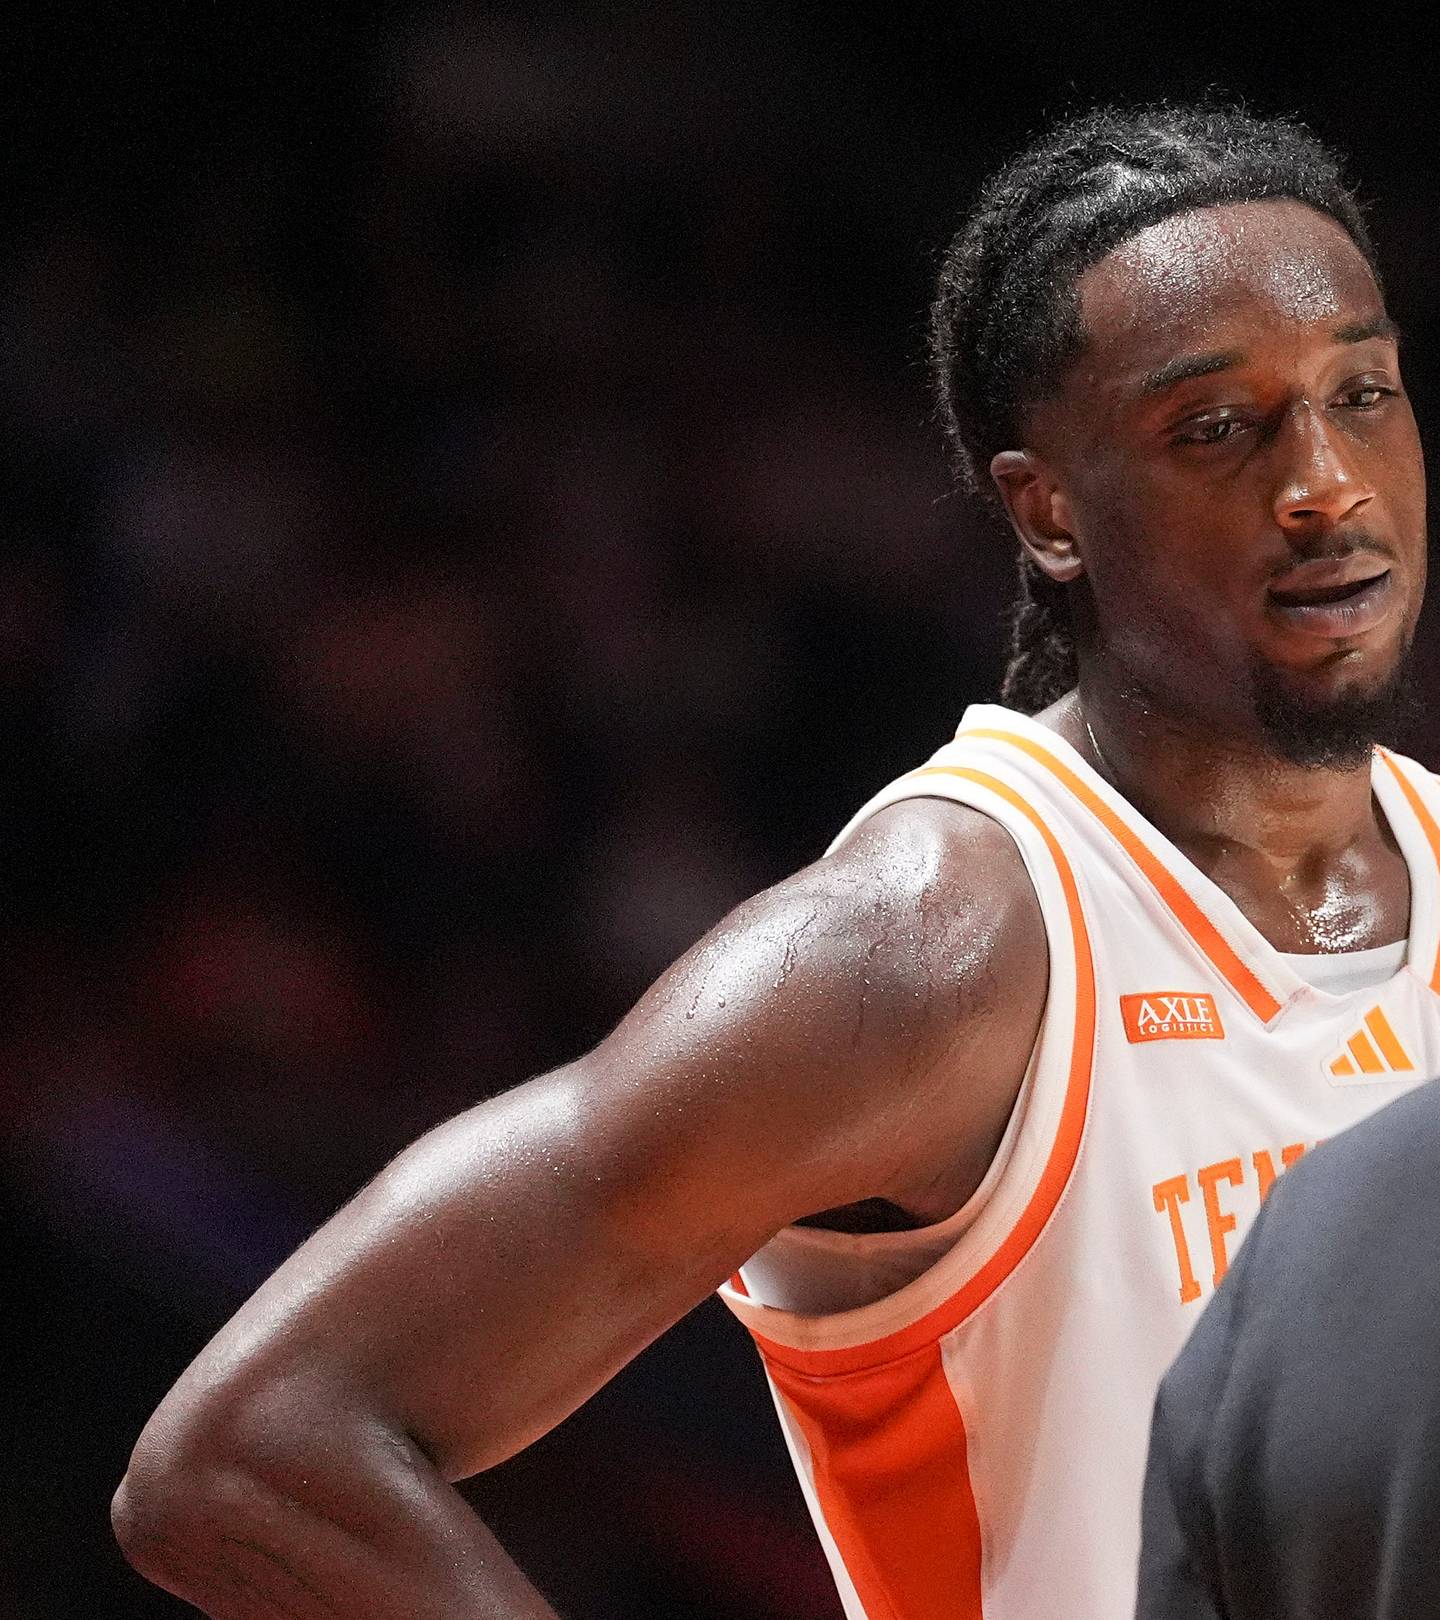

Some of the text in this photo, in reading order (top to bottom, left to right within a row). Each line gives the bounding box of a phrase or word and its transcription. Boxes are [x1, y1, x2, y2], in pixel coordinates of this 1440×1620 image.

[1138, 997, 1212, 1027] AXLE
[1140, 1023, 1214, 1036] LOGISTICS
[1152, 1137, 1328, 1305] TE
